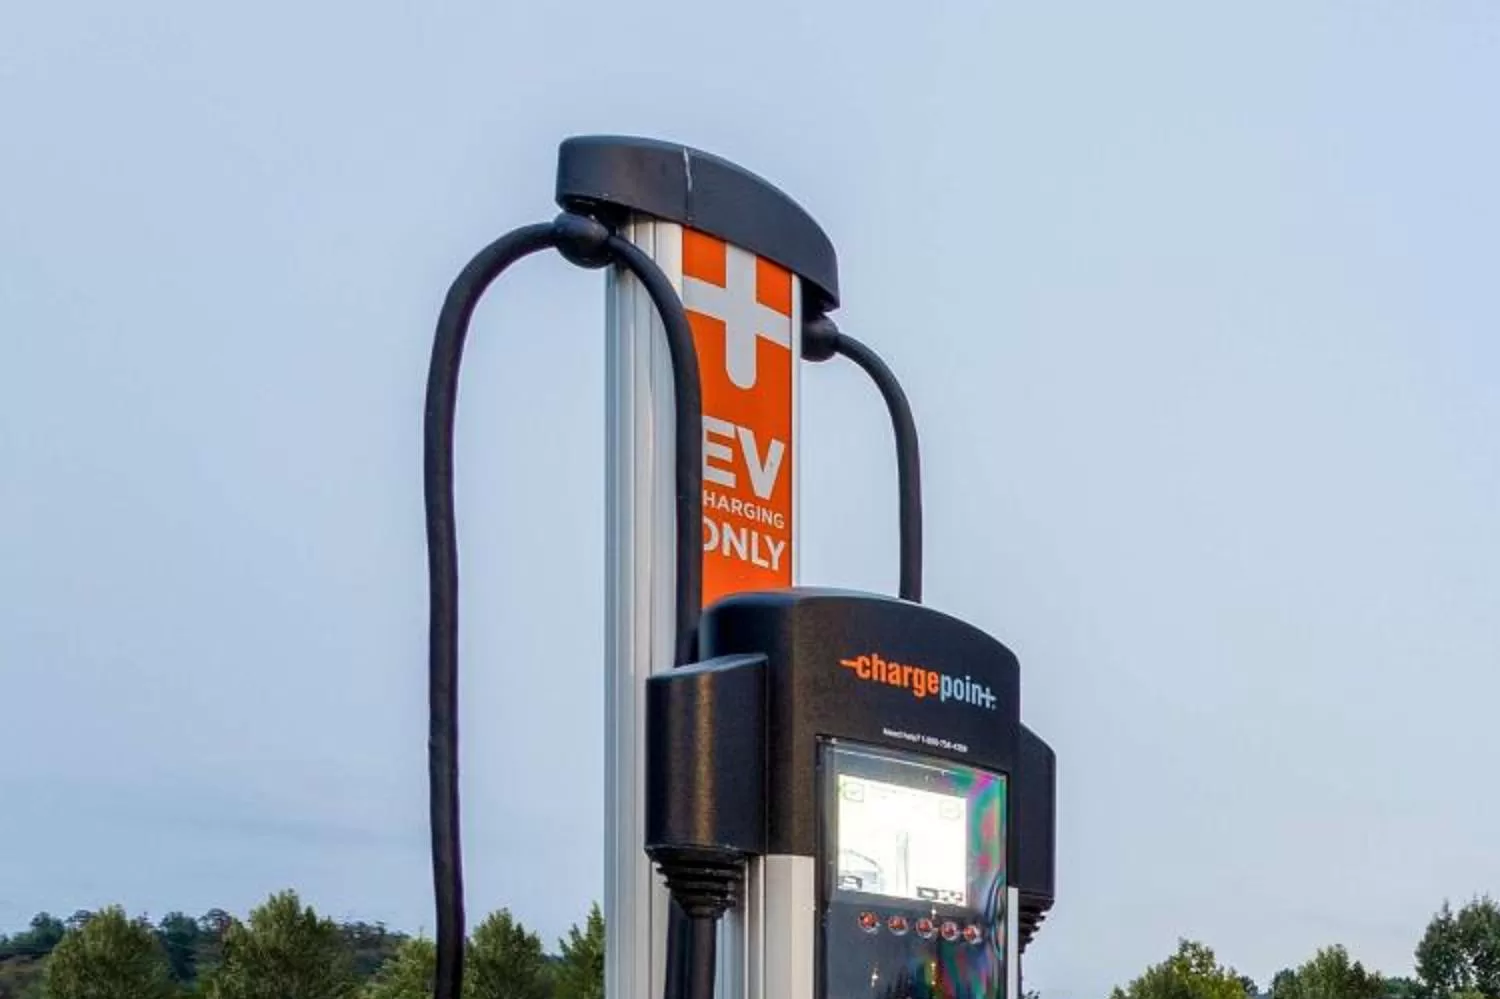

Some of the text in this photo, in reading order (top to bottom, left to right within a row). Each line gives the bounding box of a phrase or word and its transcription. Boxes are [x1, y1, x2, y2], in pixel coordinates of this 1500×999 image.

[702, 415, 785, 500] EV
[703, 490, 785, 529] HARGING
[841, 652, 997, 709] chargepoint
